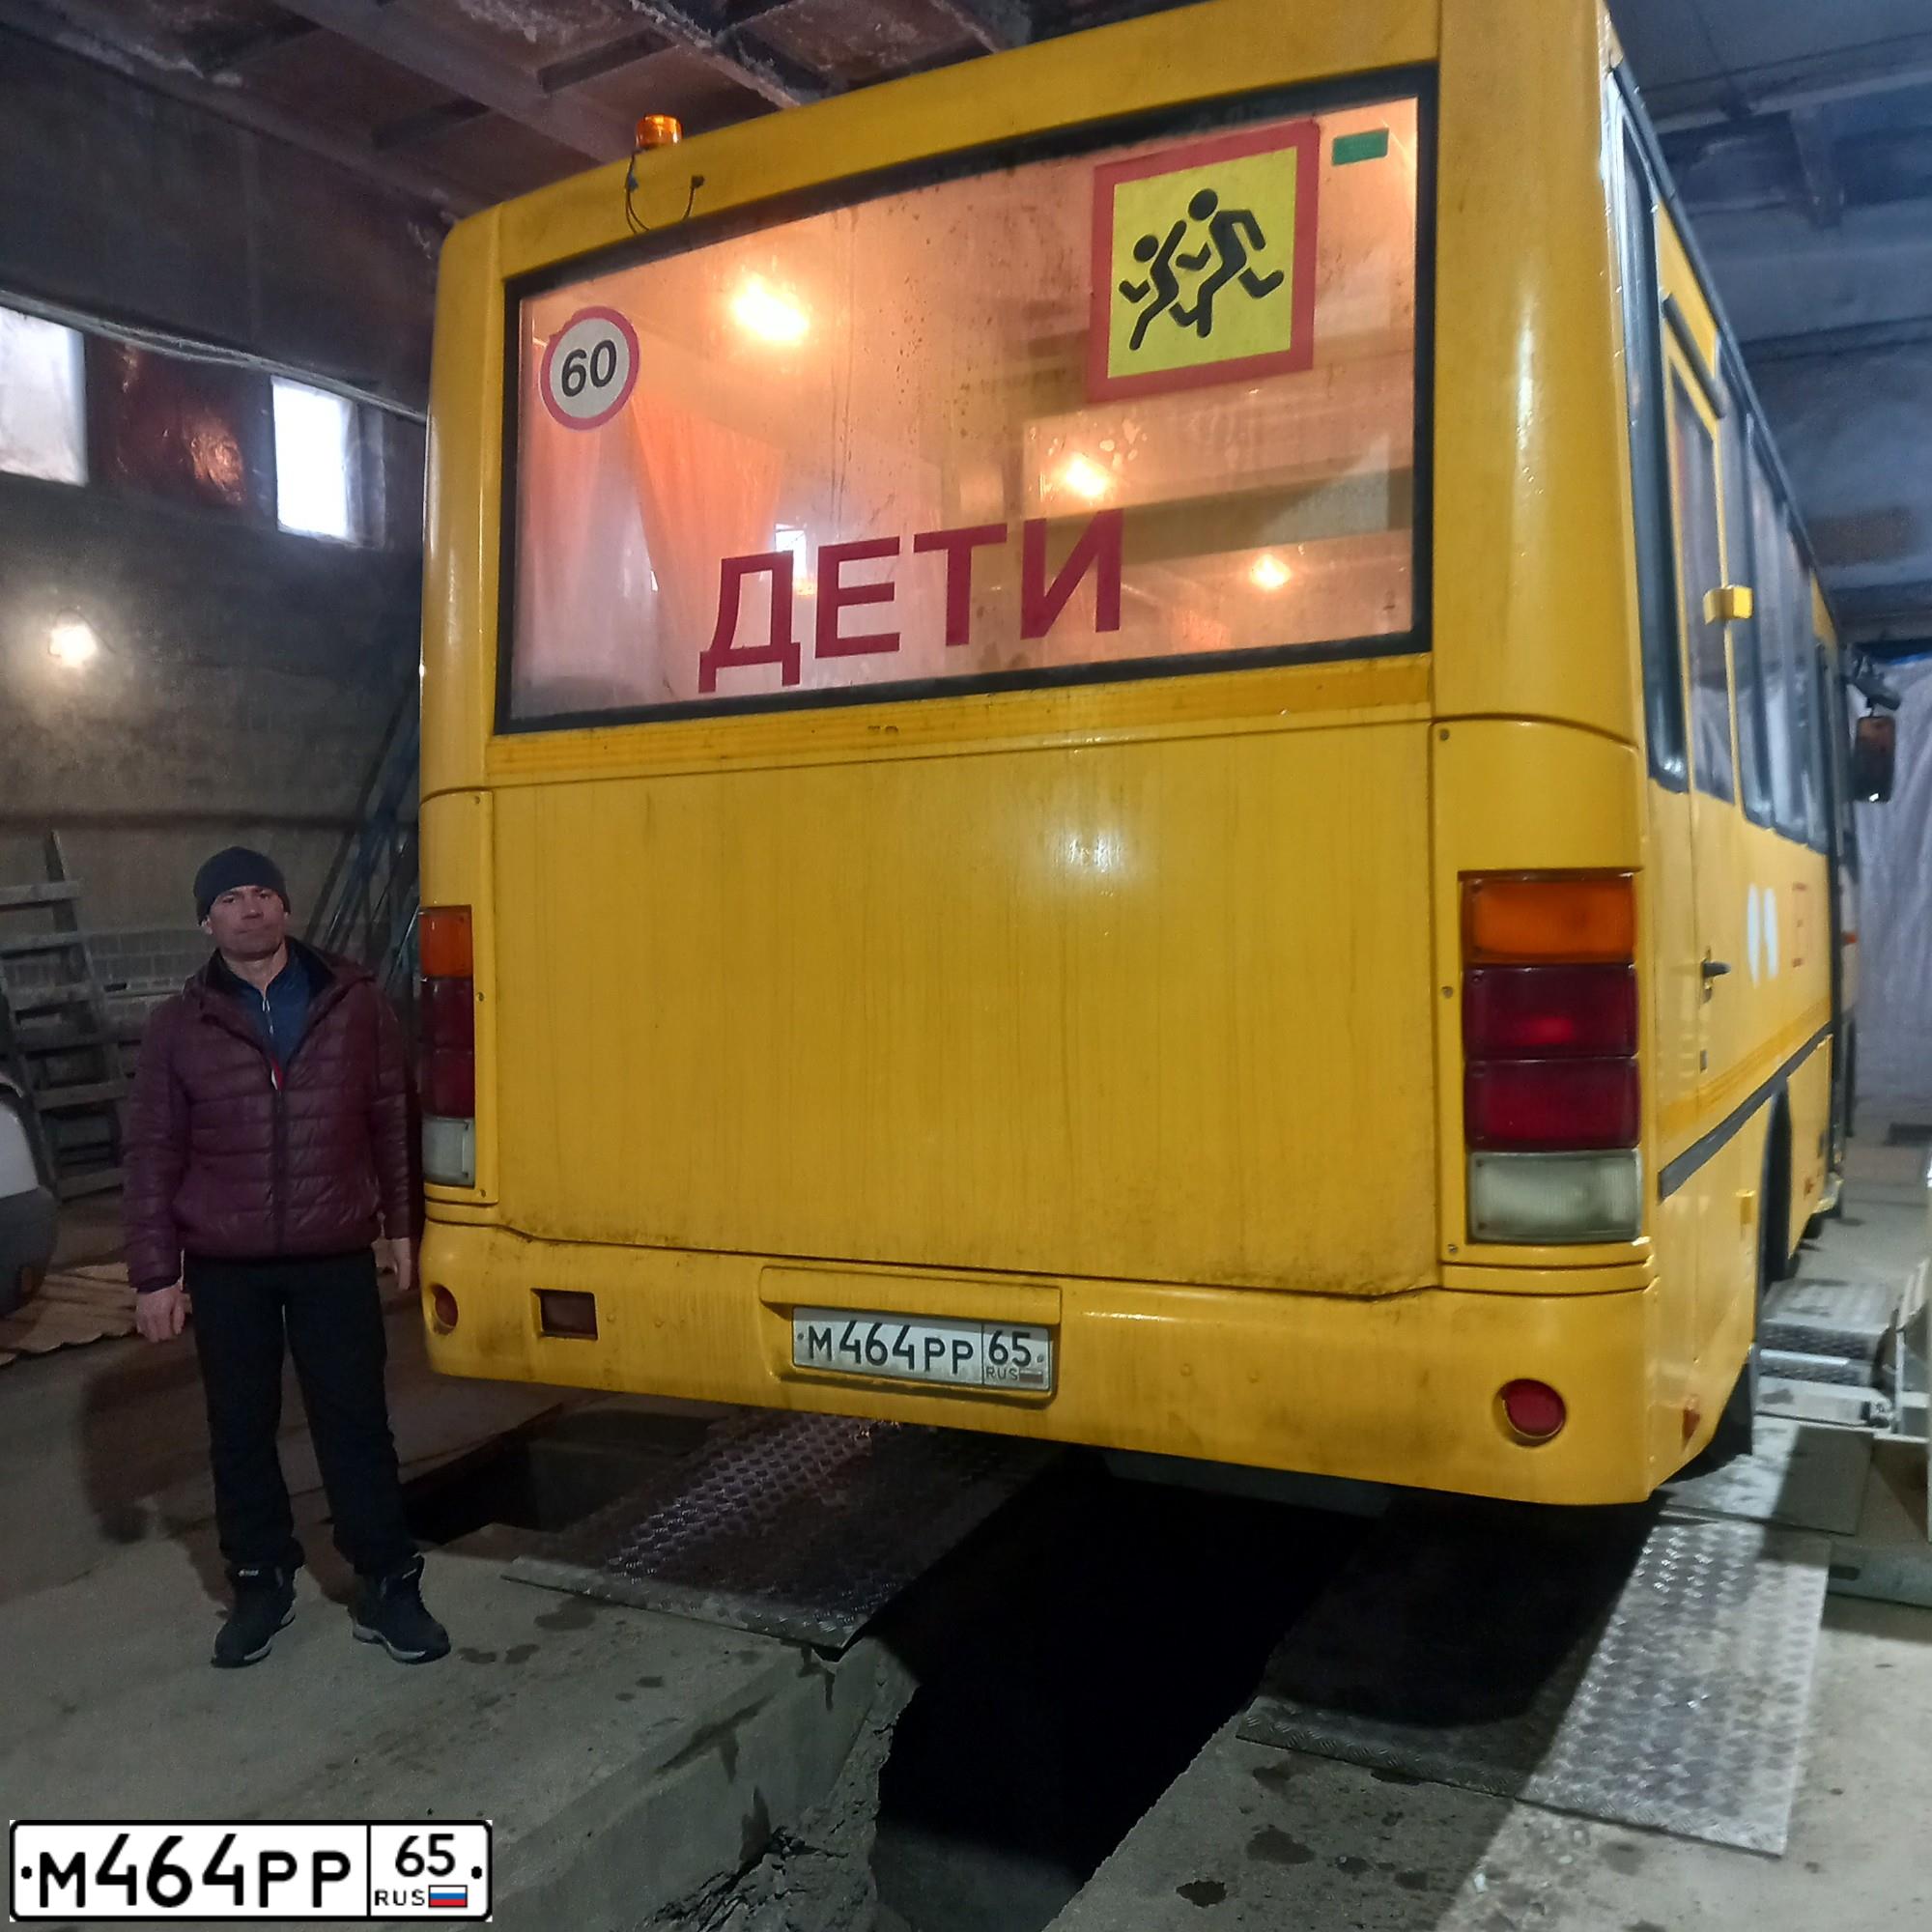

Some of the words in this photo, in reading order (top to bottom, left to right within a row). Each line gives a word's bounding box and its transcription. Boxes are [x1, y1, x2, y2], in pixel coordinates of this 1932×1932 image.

[561, 339, 617, 397] 60
[698, 508, 1123, 694] ДЕТИ
[988, 1329, 1032, 1367] 65
[985, 1366, 1018, 1381] RUS
